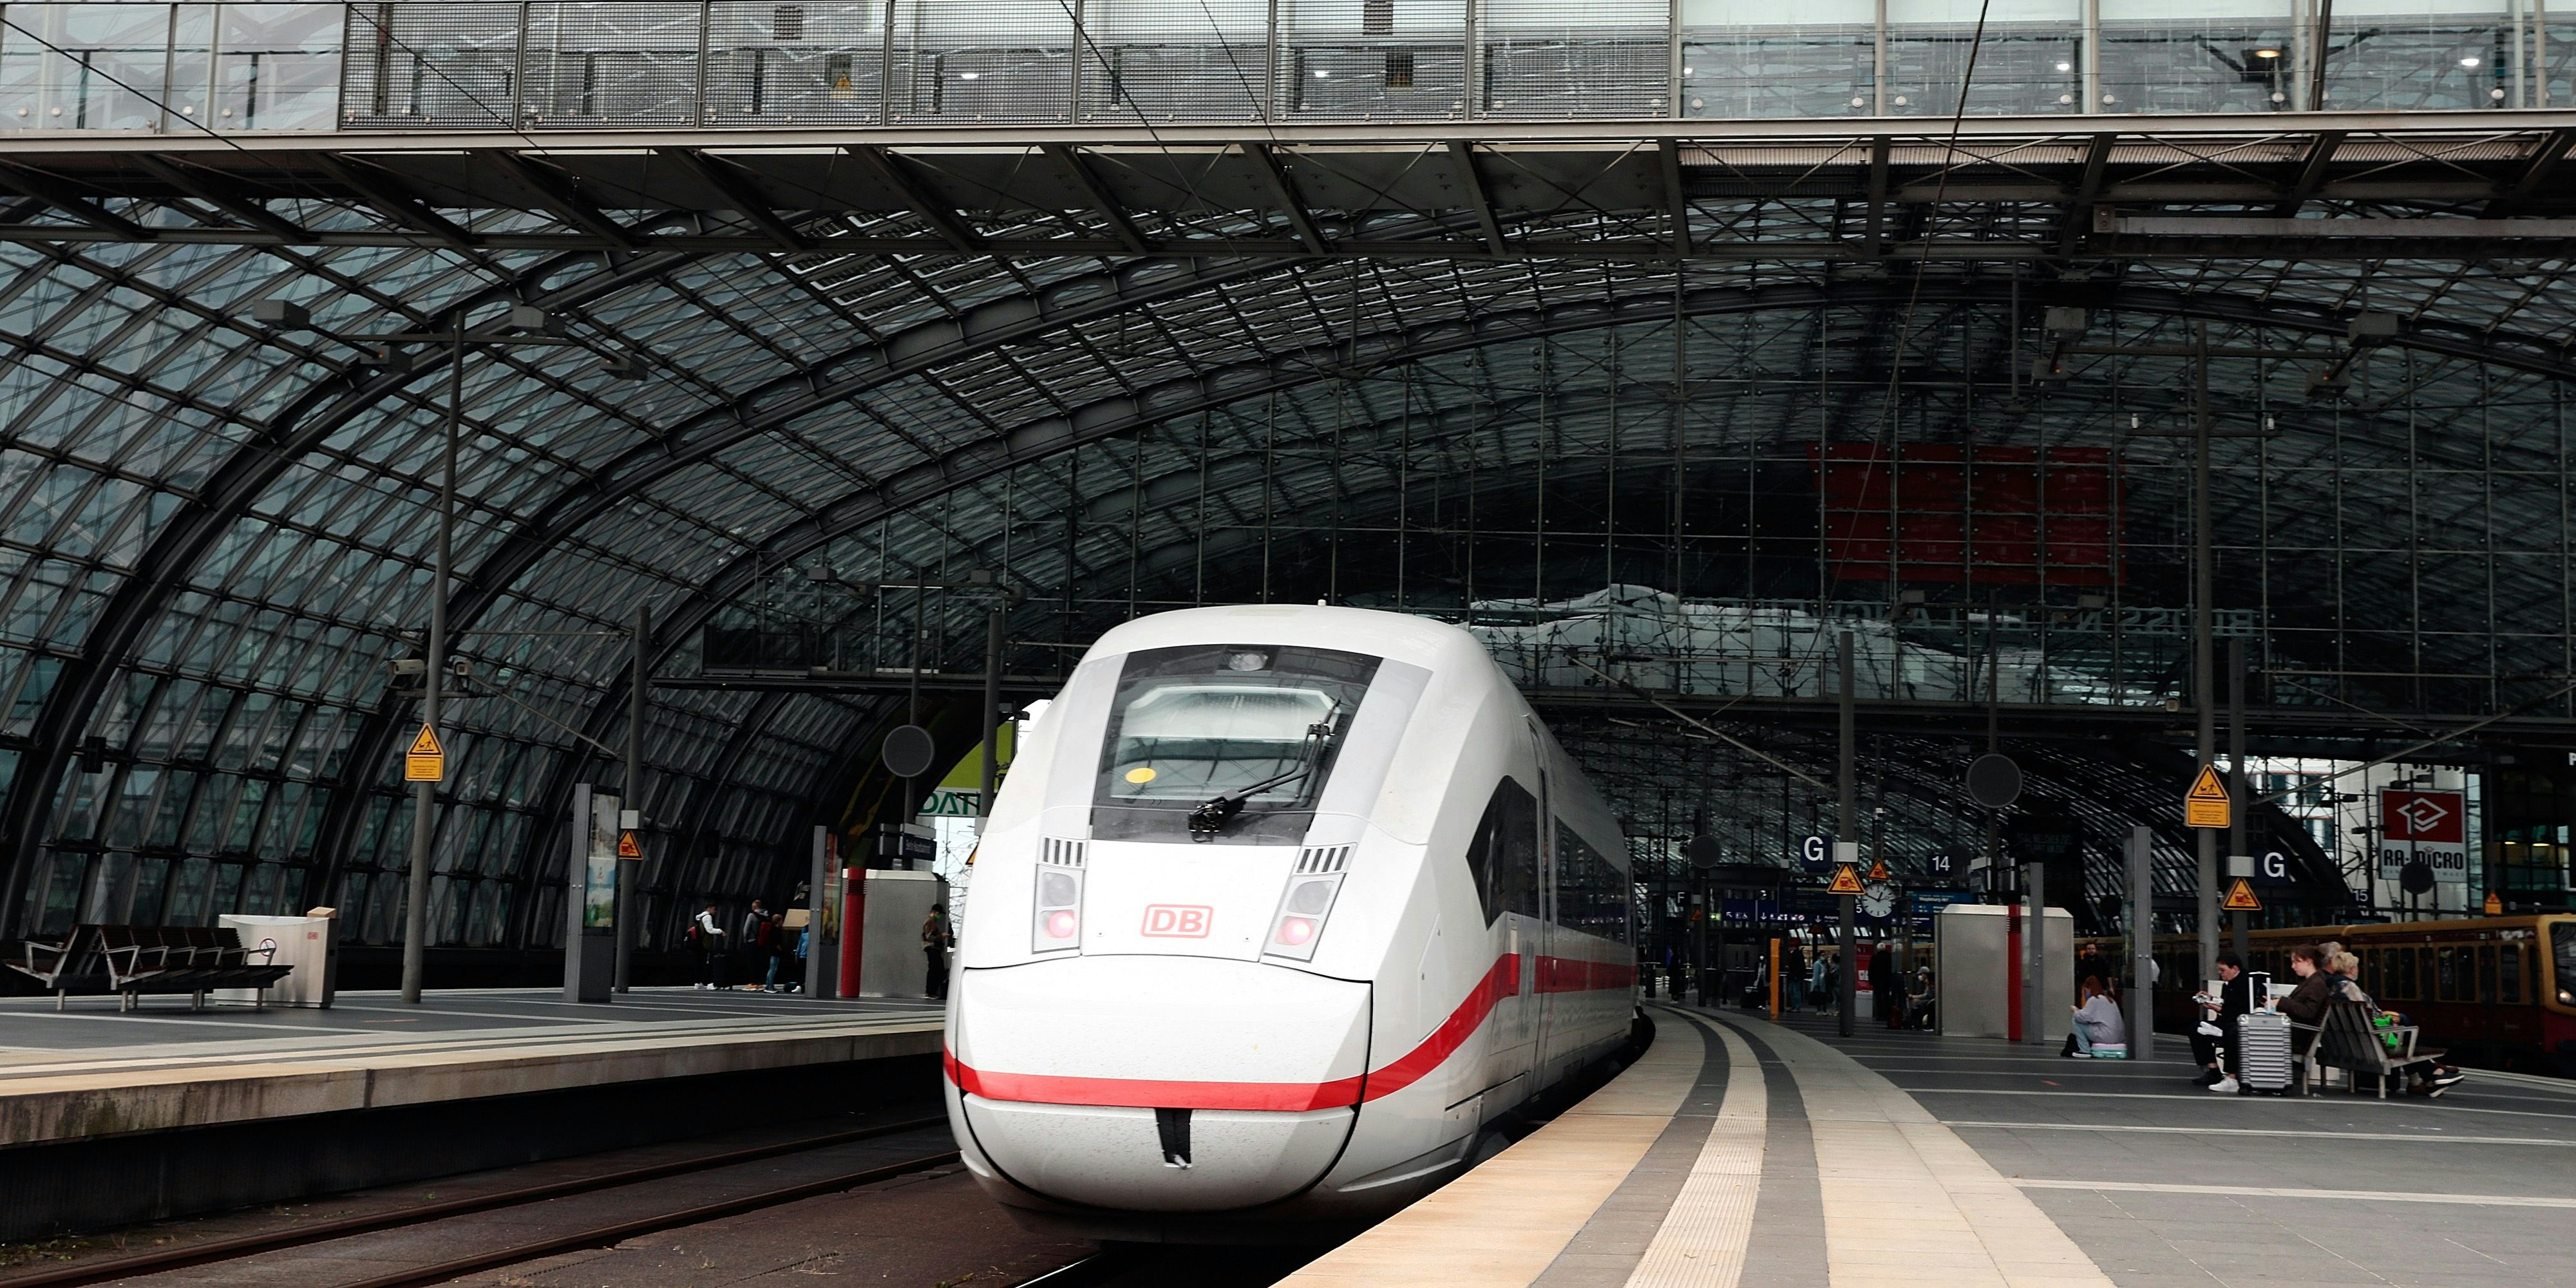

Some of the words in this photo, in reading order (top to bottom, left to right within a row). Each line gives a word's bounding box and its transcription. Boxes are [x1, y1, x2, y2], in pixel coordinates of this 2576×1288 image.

[1804, 836, 1824, 861] G
[1931, 855, 1951, 871] 14
[2263, 852, 2285, 878] G
[1677, 892, 1685, 903] F
[2352, 889, 2369, 902] 15
[1150, 909, 1202, 933] DB
